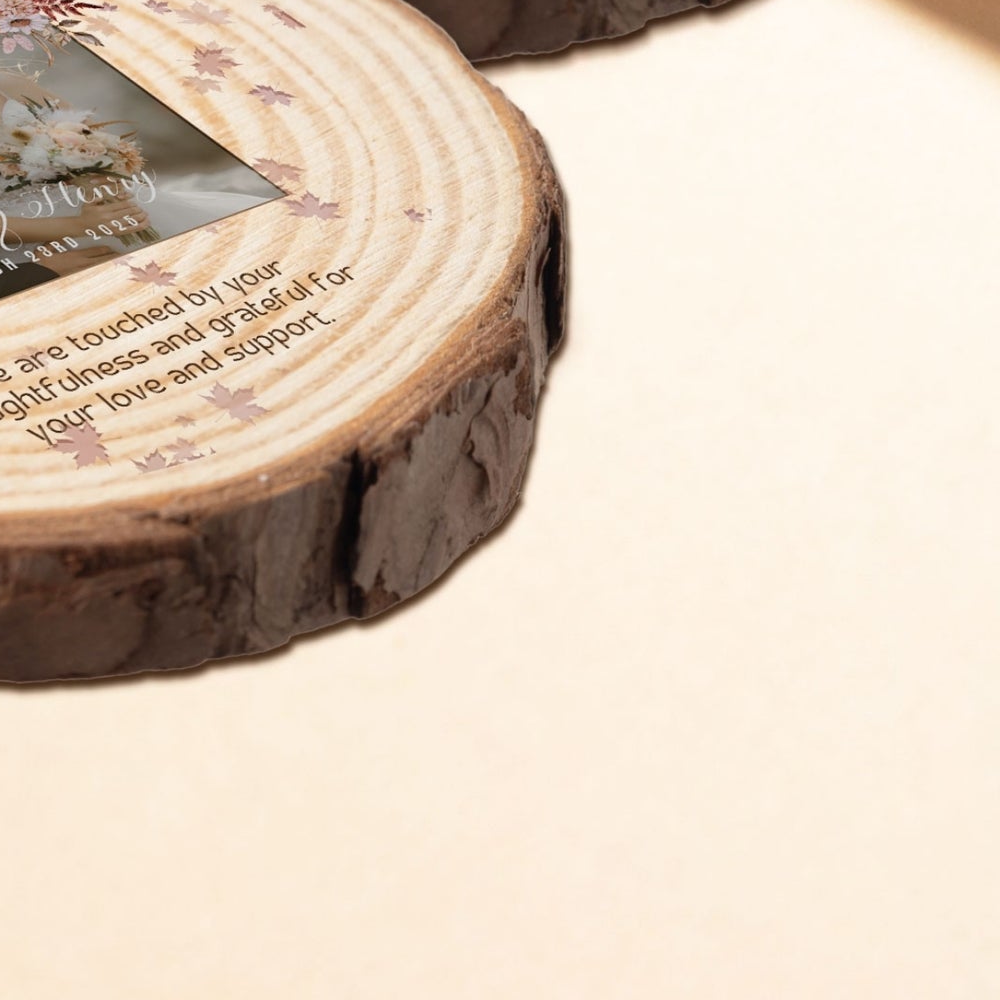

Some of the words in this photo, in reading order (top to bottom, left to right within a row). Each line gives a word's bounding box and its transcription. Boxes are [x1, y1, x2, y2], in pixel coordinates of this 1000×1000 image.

[20, 168, 157, 219] Henry
[23, 235, 79, 263] 23RD
[13, 345, 69, 374] are
[66, 295, 186, 352] touched
[178, 285, 226, 309] by
[222, 260, 283, 297] your
[150, 321, 207, 356] and
[207, 279, 316, 339] grateful
[307, 265, 356, 293] for
[25, 403, 96, 447] your
[95, 378, 167, 413] love
[166, 349, 224, 386] and
[223, 308, 338, 363] support.
